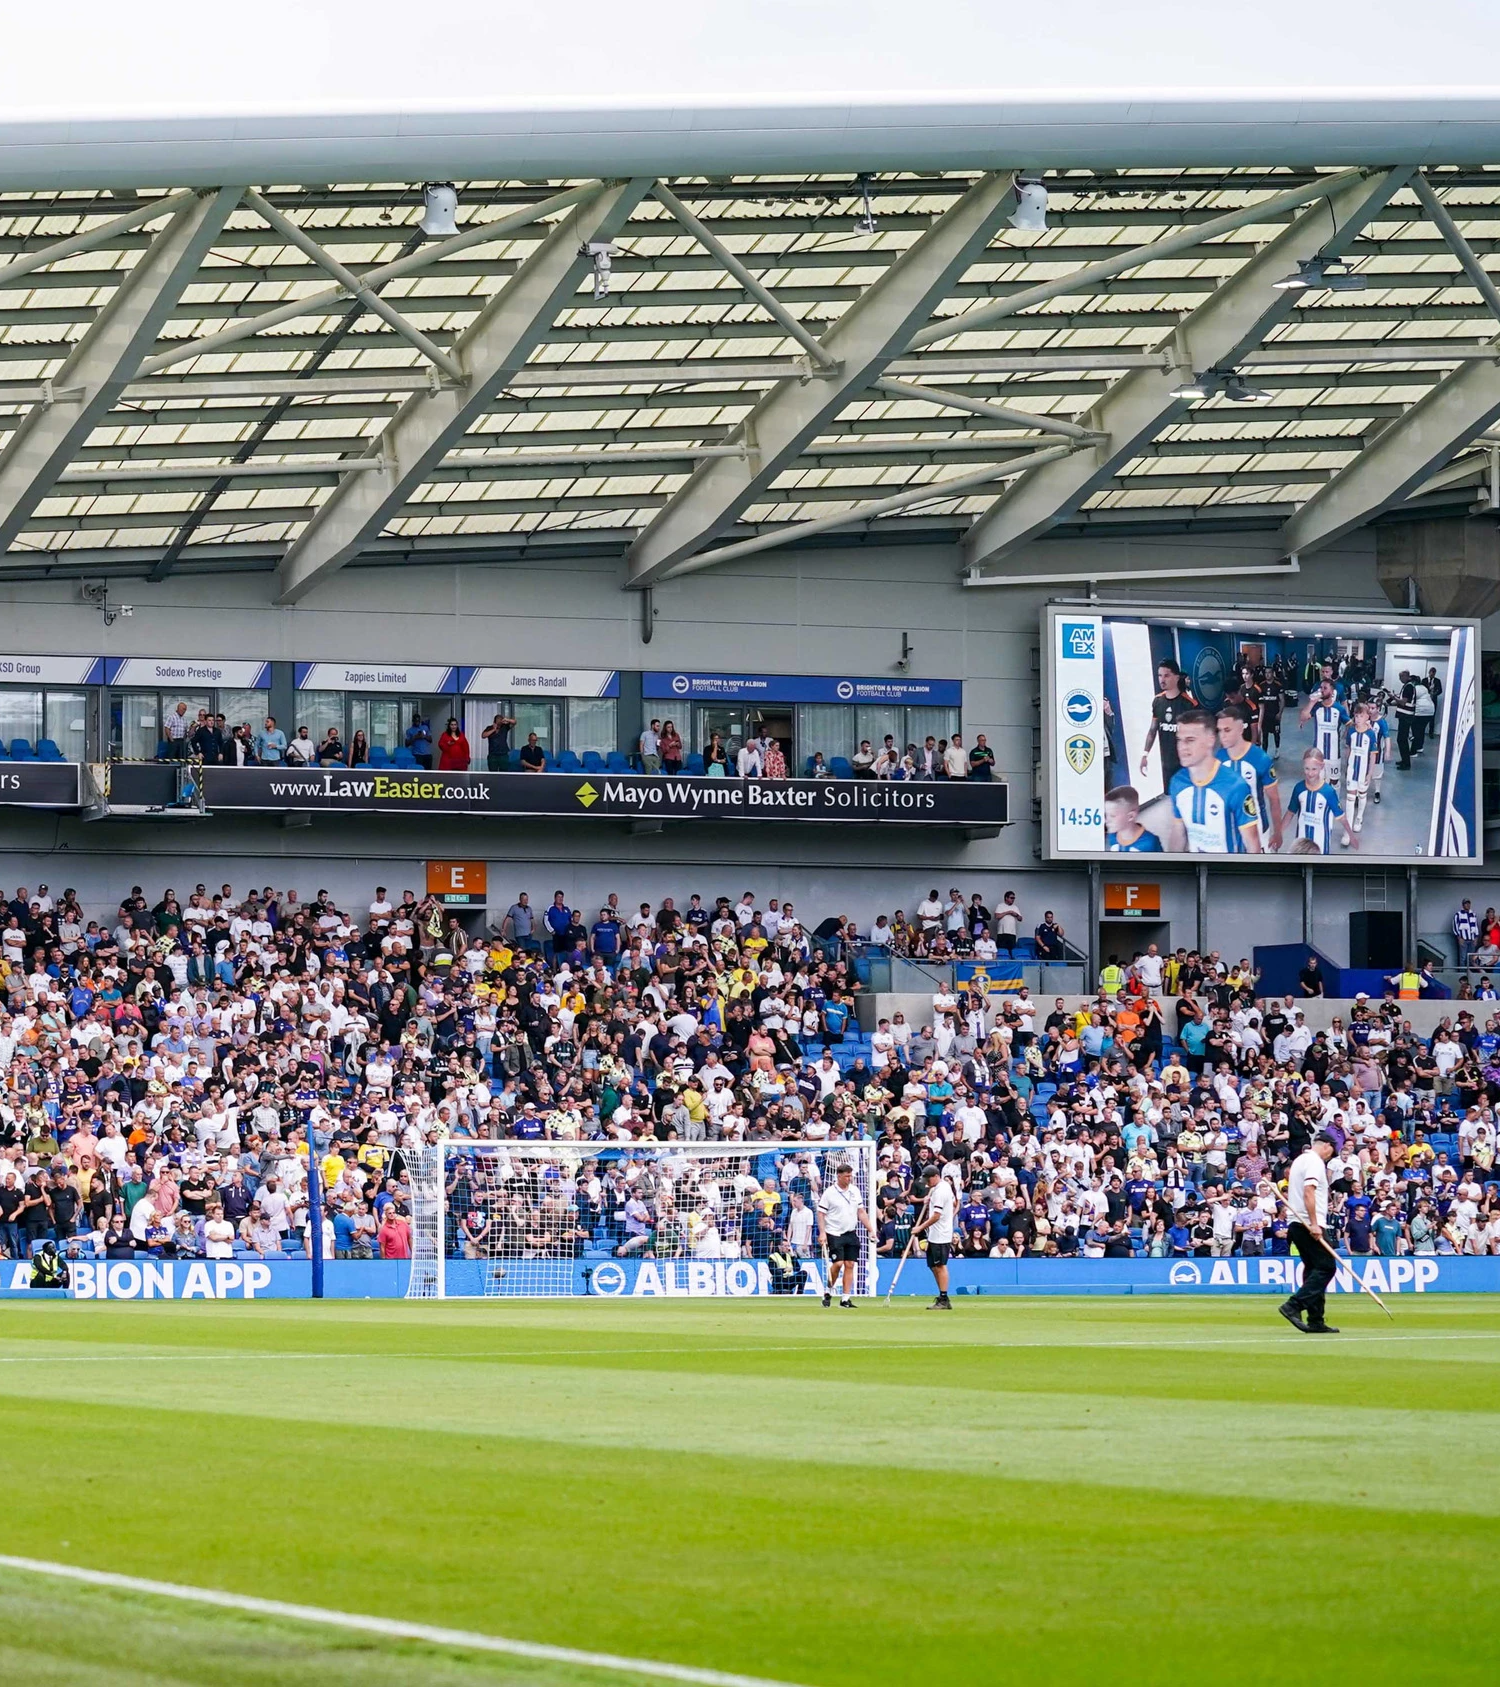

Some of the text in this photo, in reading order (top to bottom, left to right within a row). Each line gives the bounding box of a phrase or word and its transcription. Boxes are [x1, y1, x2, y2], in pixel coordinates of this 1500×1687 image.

[1070, 629, 1094, 642] AM
[1074, 641, 1094, 654] EX
[16, 663, 41, 676] Group
[156, 666, 222, 680] Sodexo Prestige
[345, 671, 407, 683] Zappies Limited
[511, 675, 567, 687] James Randall
[270, 775, 490, 800] www.LawEasier.co.uk
[603, 782, 935, 810] Mayo Wynne Baxter Solicitors
[1060, 808, 1102, 826] 14:56
[451, 867, 464, 888] E
[1126, 886, 1139, 906] F
[9, 1262, 271, 1299] ABION APP
[1360, 1259, 1439, 1293] APP
